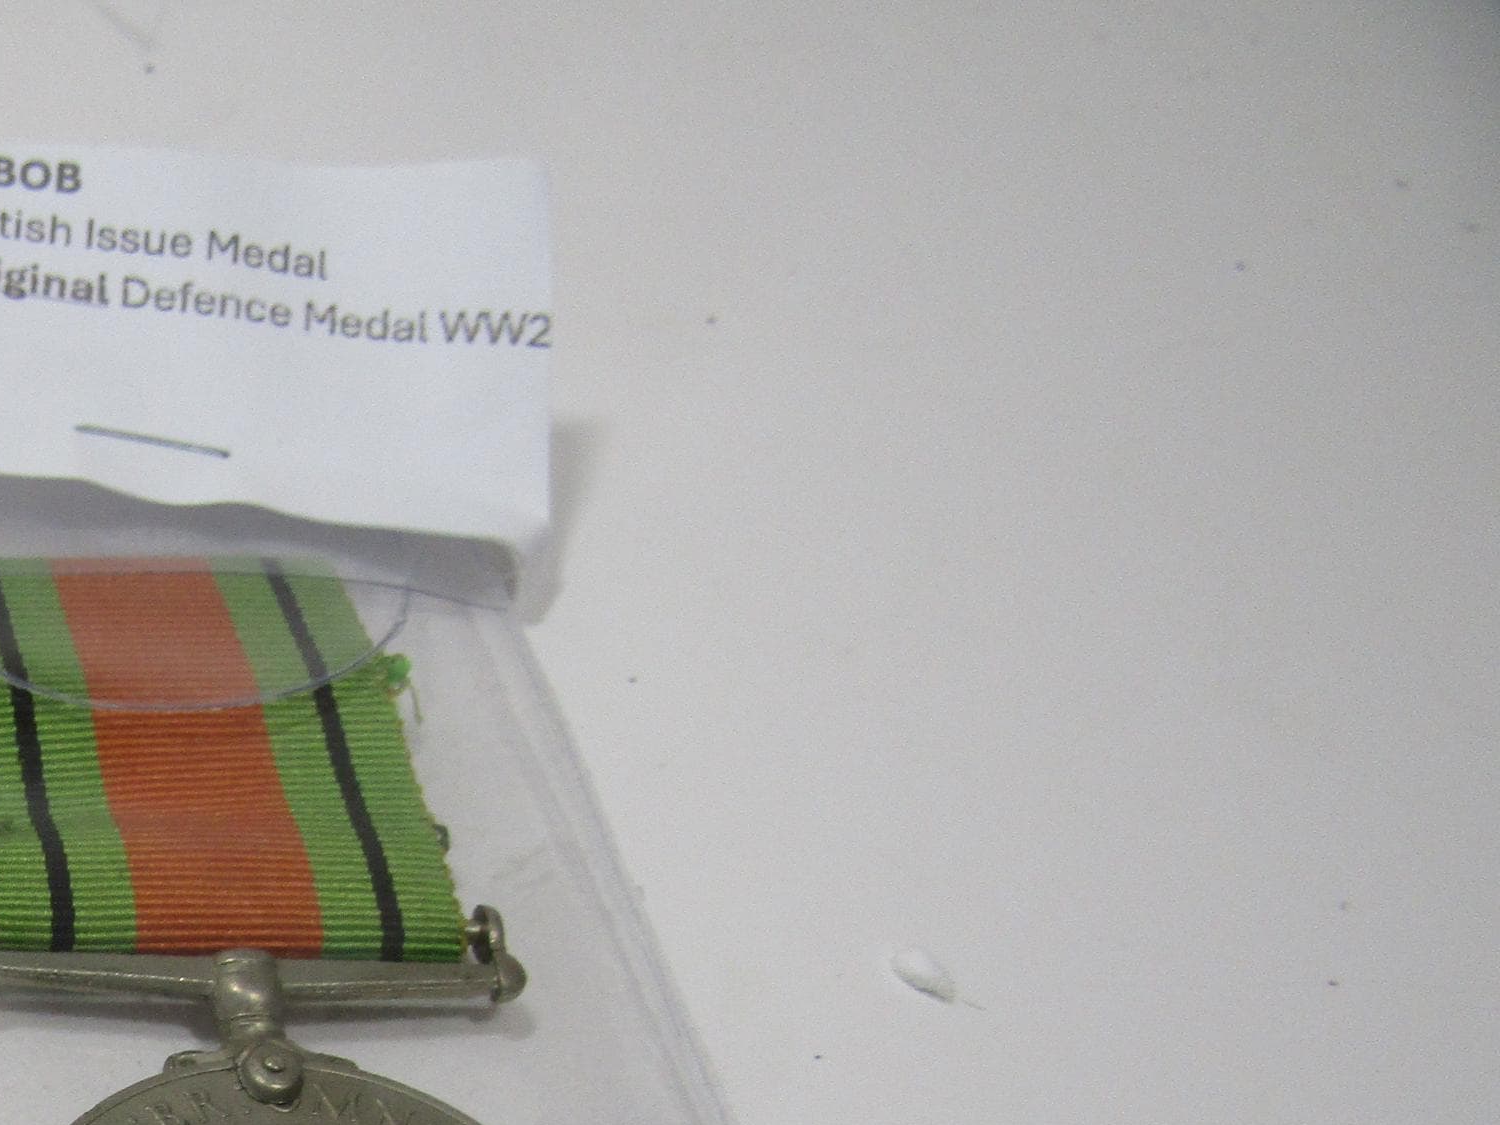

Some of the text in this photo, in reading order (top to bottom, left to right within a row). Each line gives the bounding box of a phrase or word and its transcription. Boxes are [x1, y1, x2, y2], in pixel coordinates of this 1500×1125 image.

[87, 219, 192, 257] Issue
[208, 230, 326, 280] Medal
[122, 276, 291, 327] Defence
[305, 301, 427, 342] Medal
[440, 311, 550, 348] WW2
